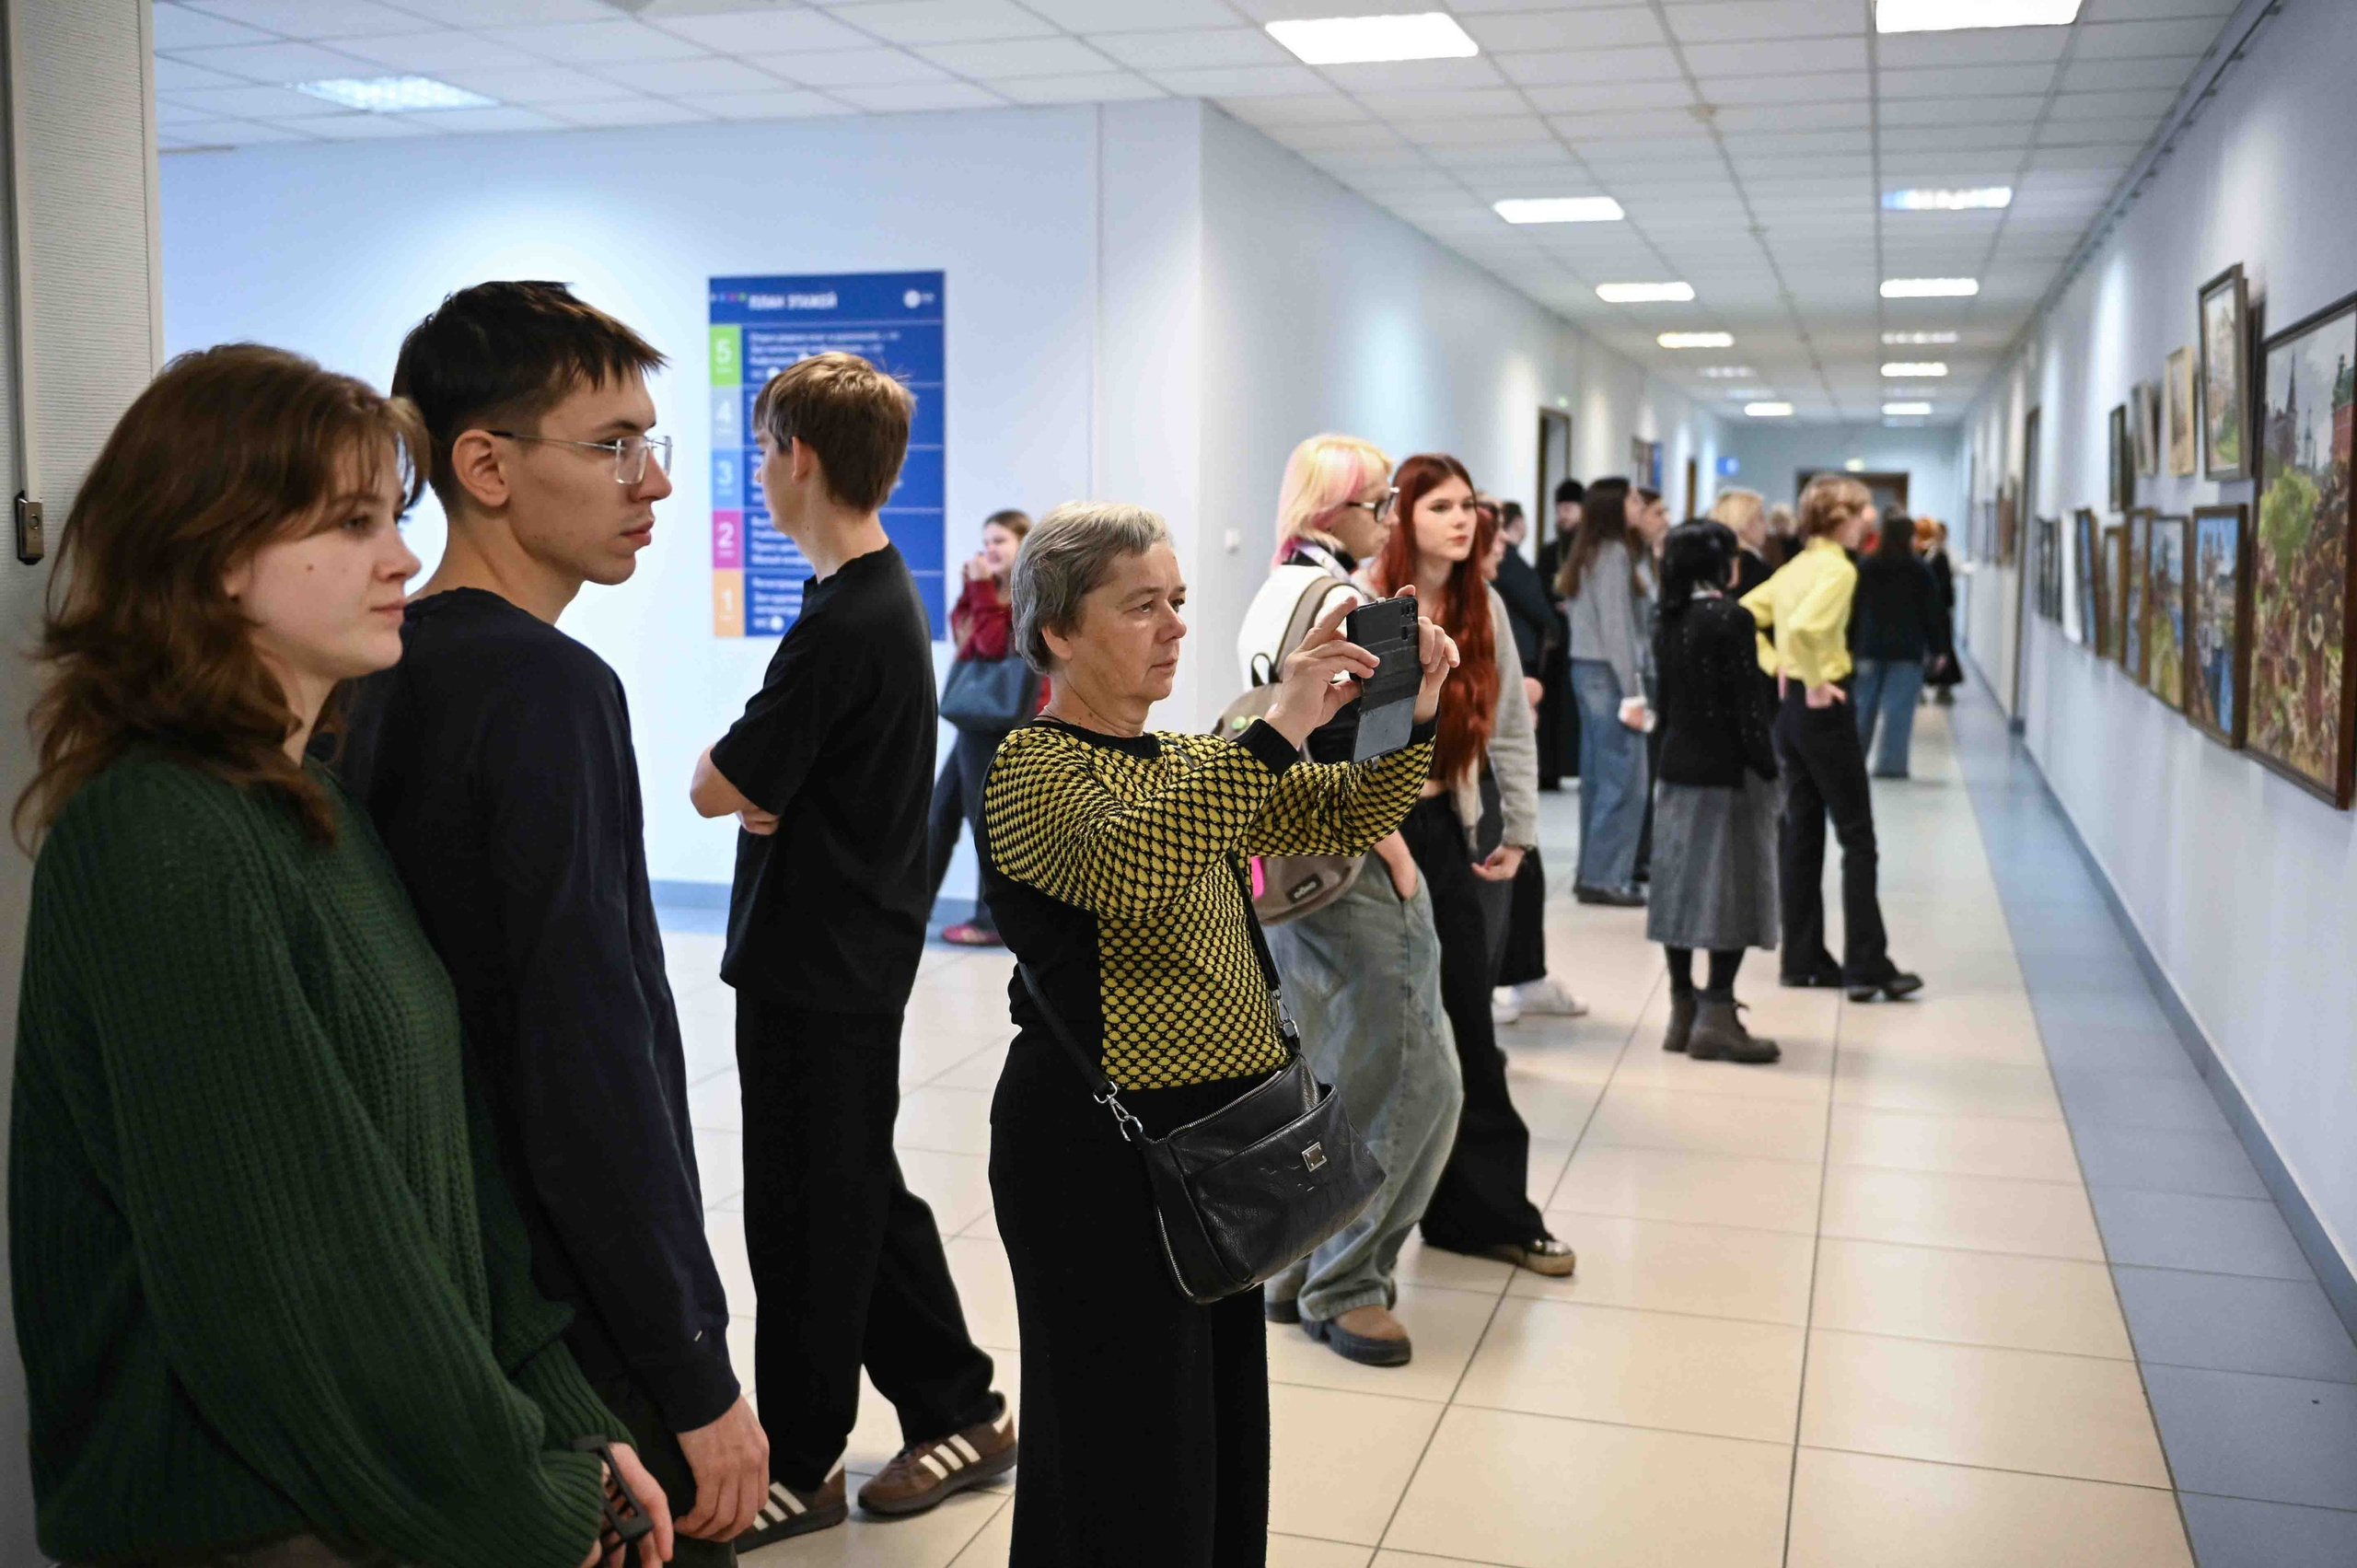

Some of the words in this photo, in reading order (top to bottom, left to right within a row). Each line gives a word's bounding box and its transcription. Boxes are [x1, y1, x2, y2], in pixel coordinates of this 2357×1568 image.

[749, 294, 784, 309] ПЛАН
[787, 291, 838, 309] ЭТАЖЕЙ
[715, 338, 732, 364] 5
[715, 401, 733, 423] 4
[717, 460, 733, 485] 3
[717, 521, 735, 549] 2
[722, 587, 733, 611] 1
